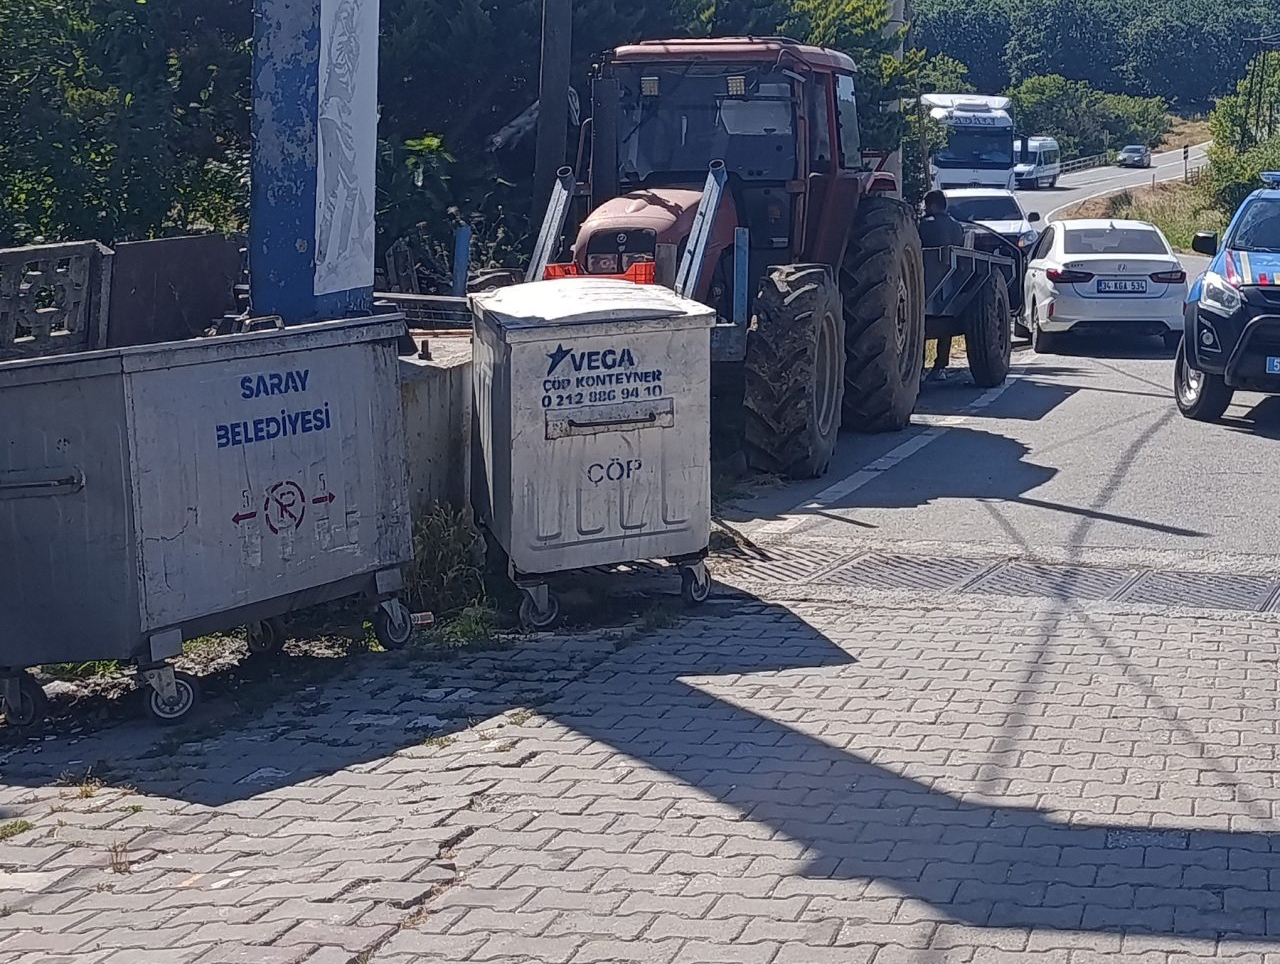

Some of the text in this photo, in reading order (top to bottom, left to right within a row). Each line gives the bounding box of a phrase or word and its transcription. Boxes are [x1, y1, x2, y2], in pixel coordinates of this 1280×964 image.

[1102, 281, 1111, 290] 34
[1131, 281, 1144, 290] 534
[570, 348, 635, 372] VEGA
[240, 369, 310, 399] SARAY
[543, 369, 663, 394] ÇÖP KONTEYNER
[541, 384, 663, 408] 0 212 886 94 10
[215, 401, 331, 449] BELEDİYESİ
[587, 457, 642, 488] ÇÖP
